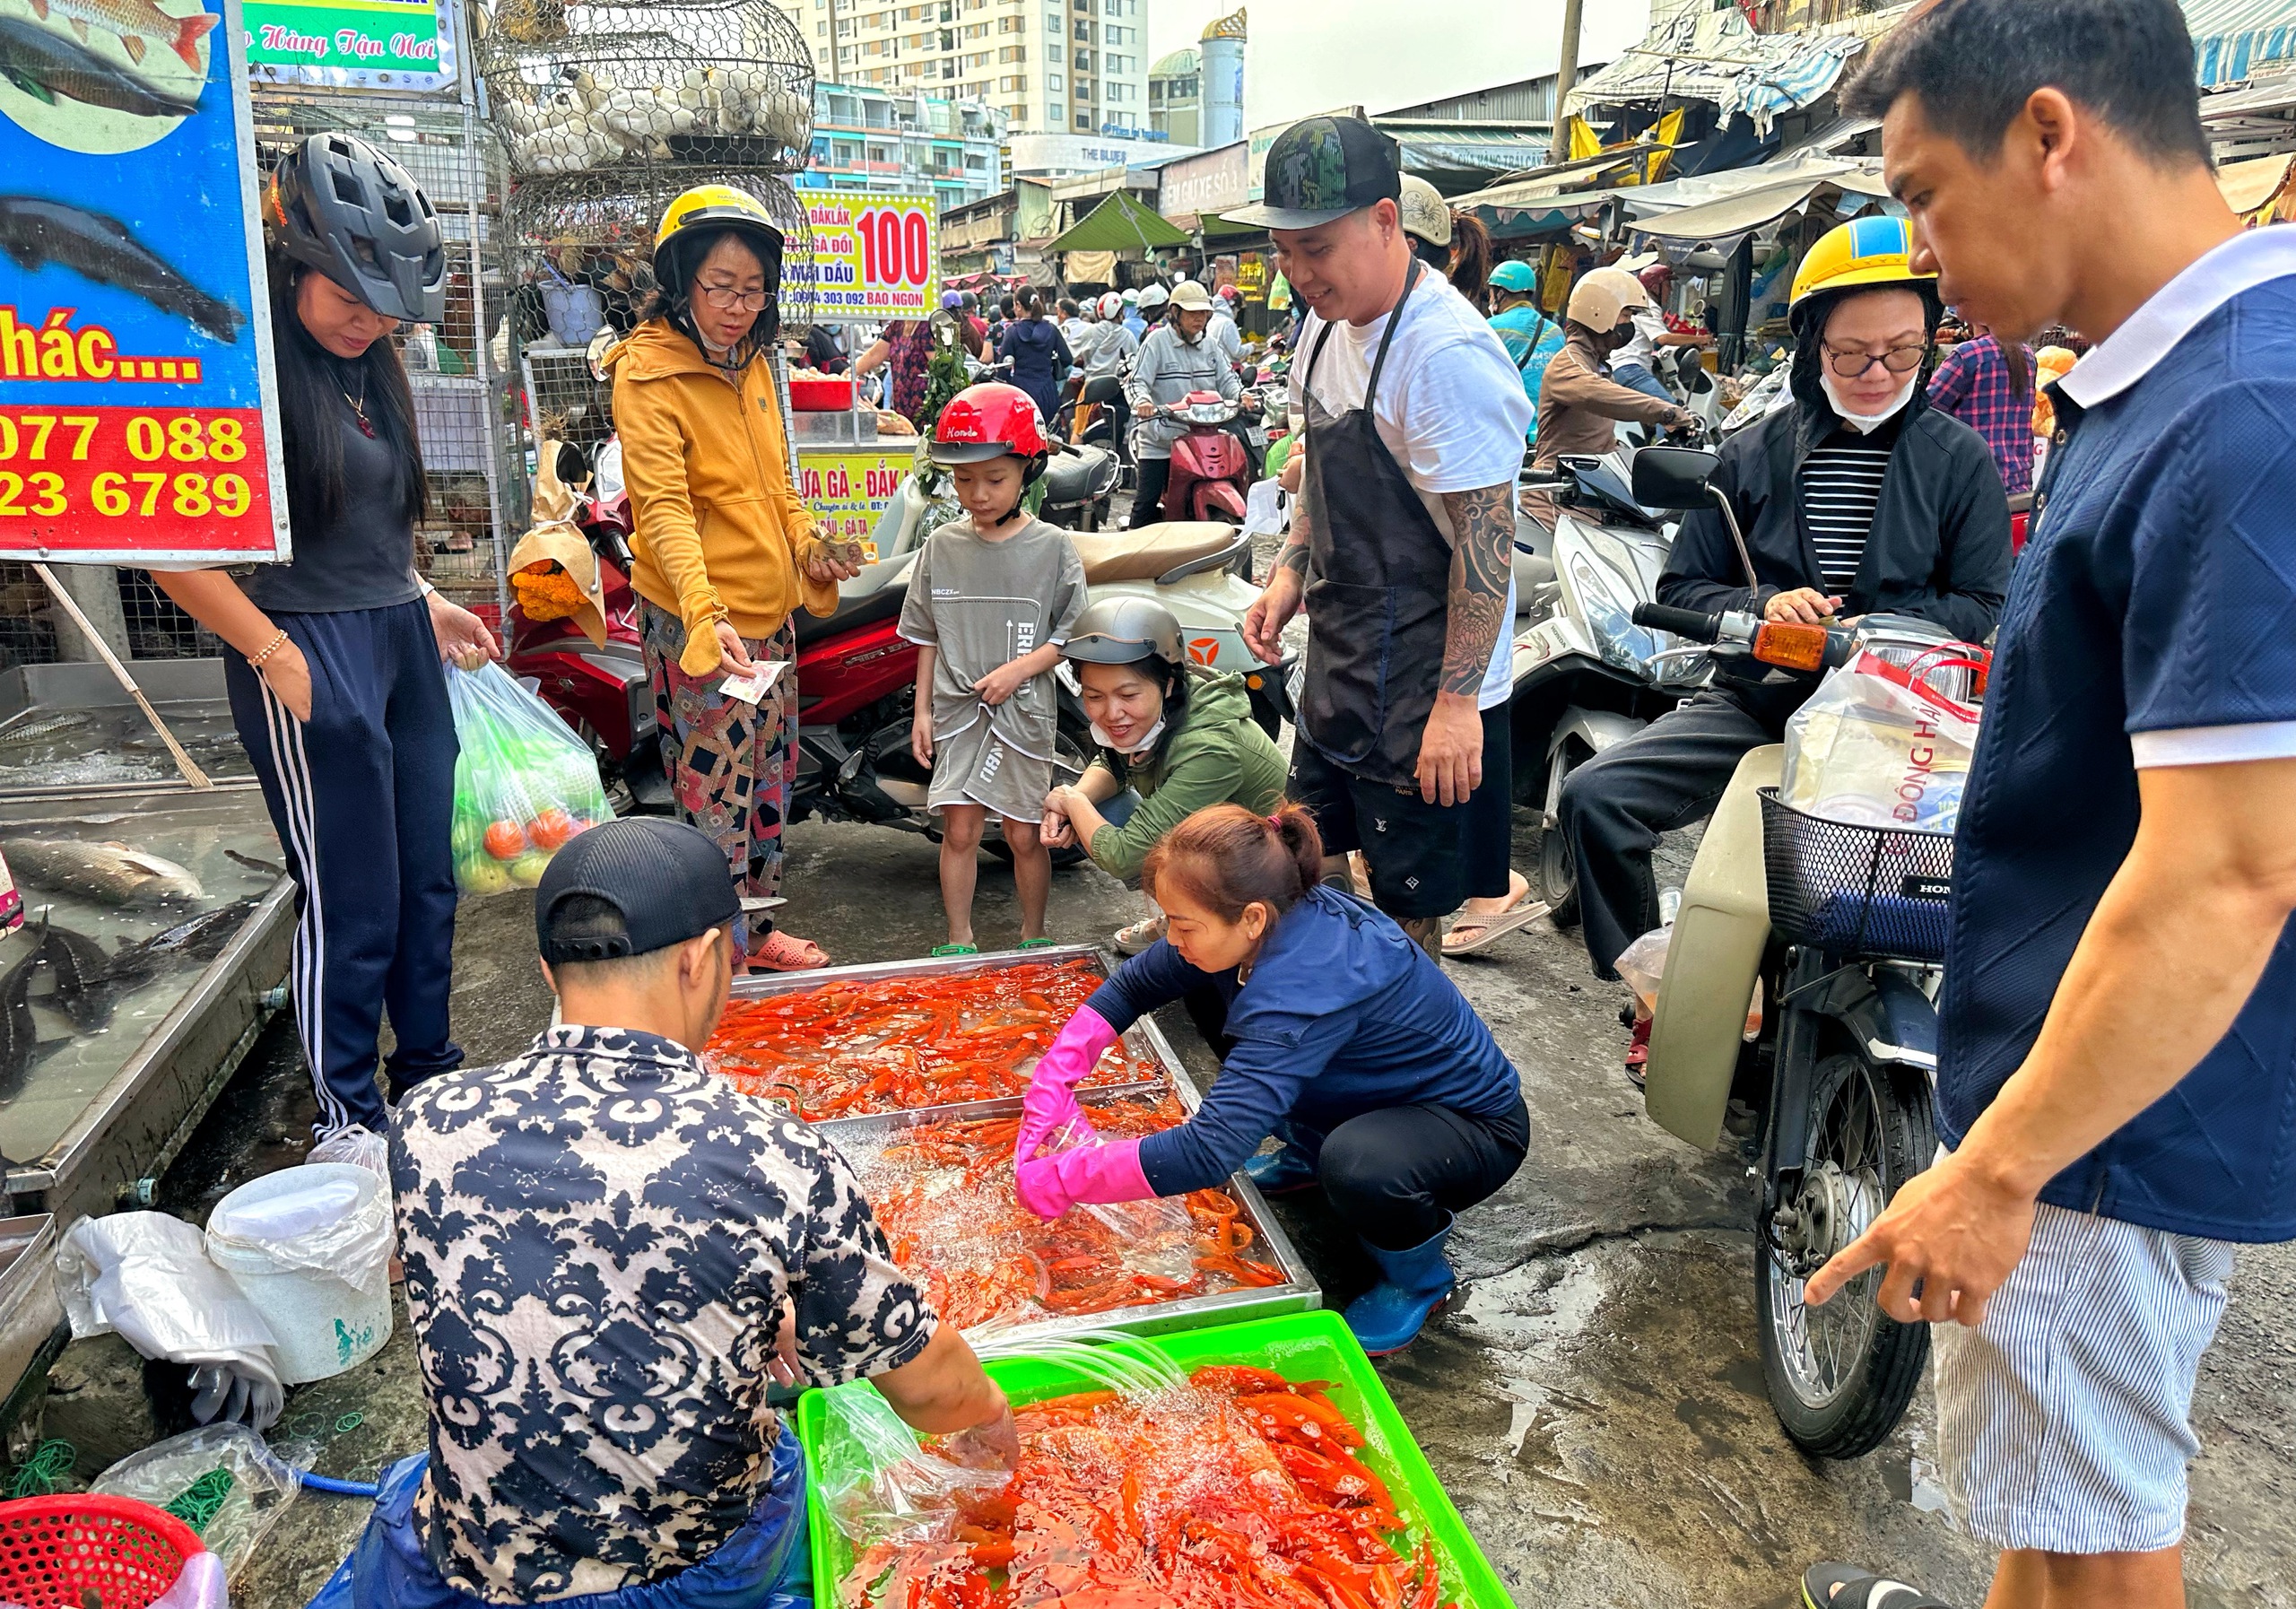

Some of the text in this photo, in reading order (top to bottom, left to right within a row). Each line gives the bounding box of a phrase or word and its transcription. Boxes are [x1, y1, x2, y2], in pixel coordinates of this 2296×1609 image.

[260, 25, 327, 57] Hàng
[337, 30, 384, 59] Tận
[392, 33, 437, 58] Nơi
[1082, 148, 1098, 161] THE
[857, 211, 928, 285] 100
[823, 292, 843, 304] 303
[846, 293, 865, 305] 092
[866, 292, 889, 305] BAO
[891, 293, 924, 306] NGON
[0, 309, 199, 379] hác....
[126, 416, 248, 463] 088
[91, 472, 251, 517] 6789
[800, 467, 822, 505] ỰA
[826, 464, 850, 499] GÀ
[866, 459, 899, 498] ĐẮK
[858, 518, 868, 535] TA
[1550, 624, 1567, 648] HONDA
[1892, 747, 1934, 823] ĐÔNG
[1918, 883, 1951, 894] HON
